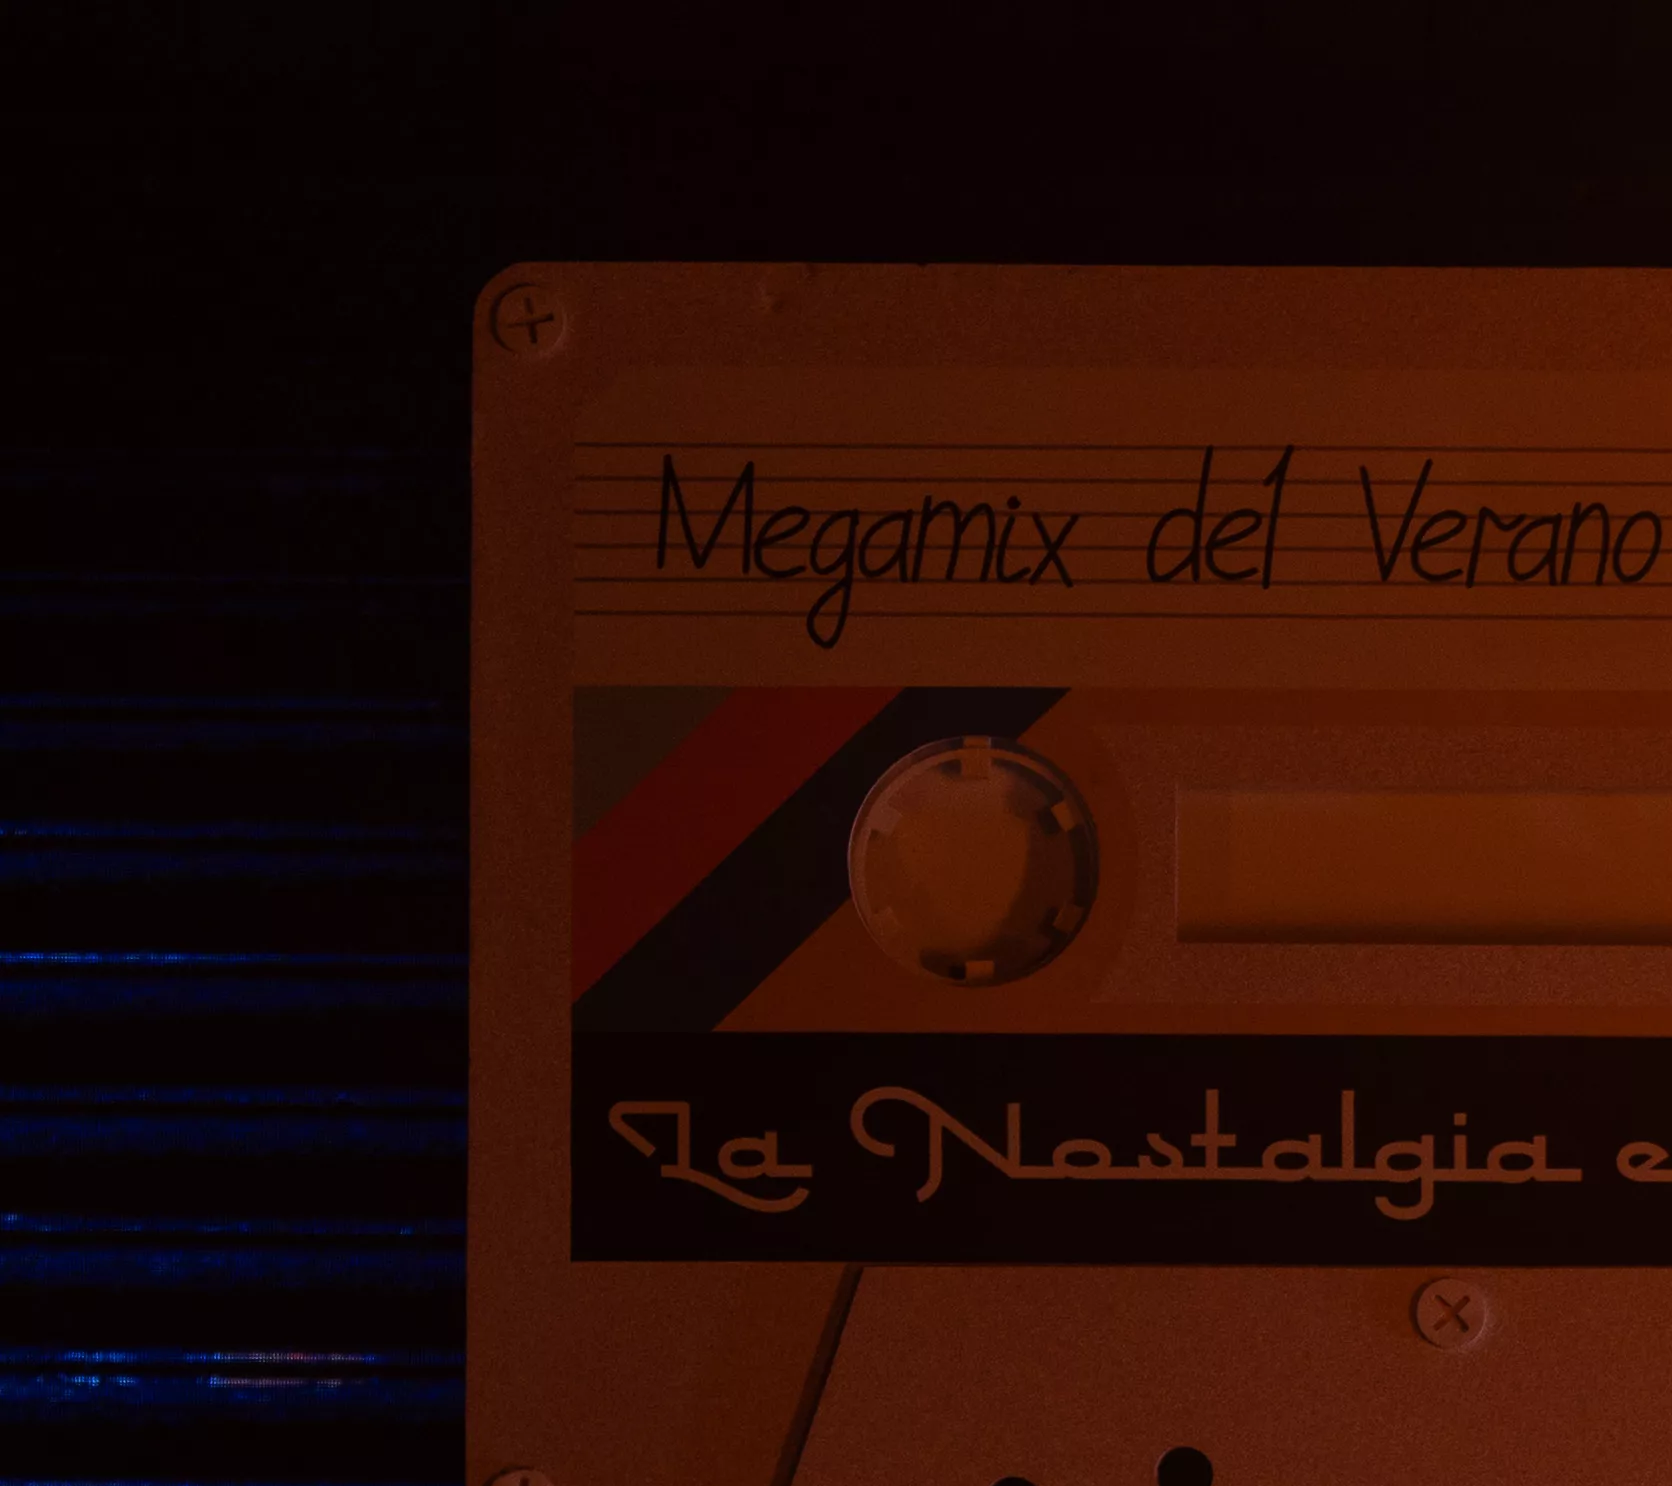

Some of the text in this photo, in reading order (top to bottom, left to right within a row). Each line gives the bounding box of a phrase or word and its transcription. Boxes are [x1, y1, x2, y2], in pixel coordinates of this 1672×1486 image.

[655, 452, 1078, 649] Megamix
[1147, 445, 1294, 592] del
[1358, 458, 1663, 588] Verano
[606, 1100, 813, 1213] La
[848, 1086, 1581, 1219] Nostalgia
